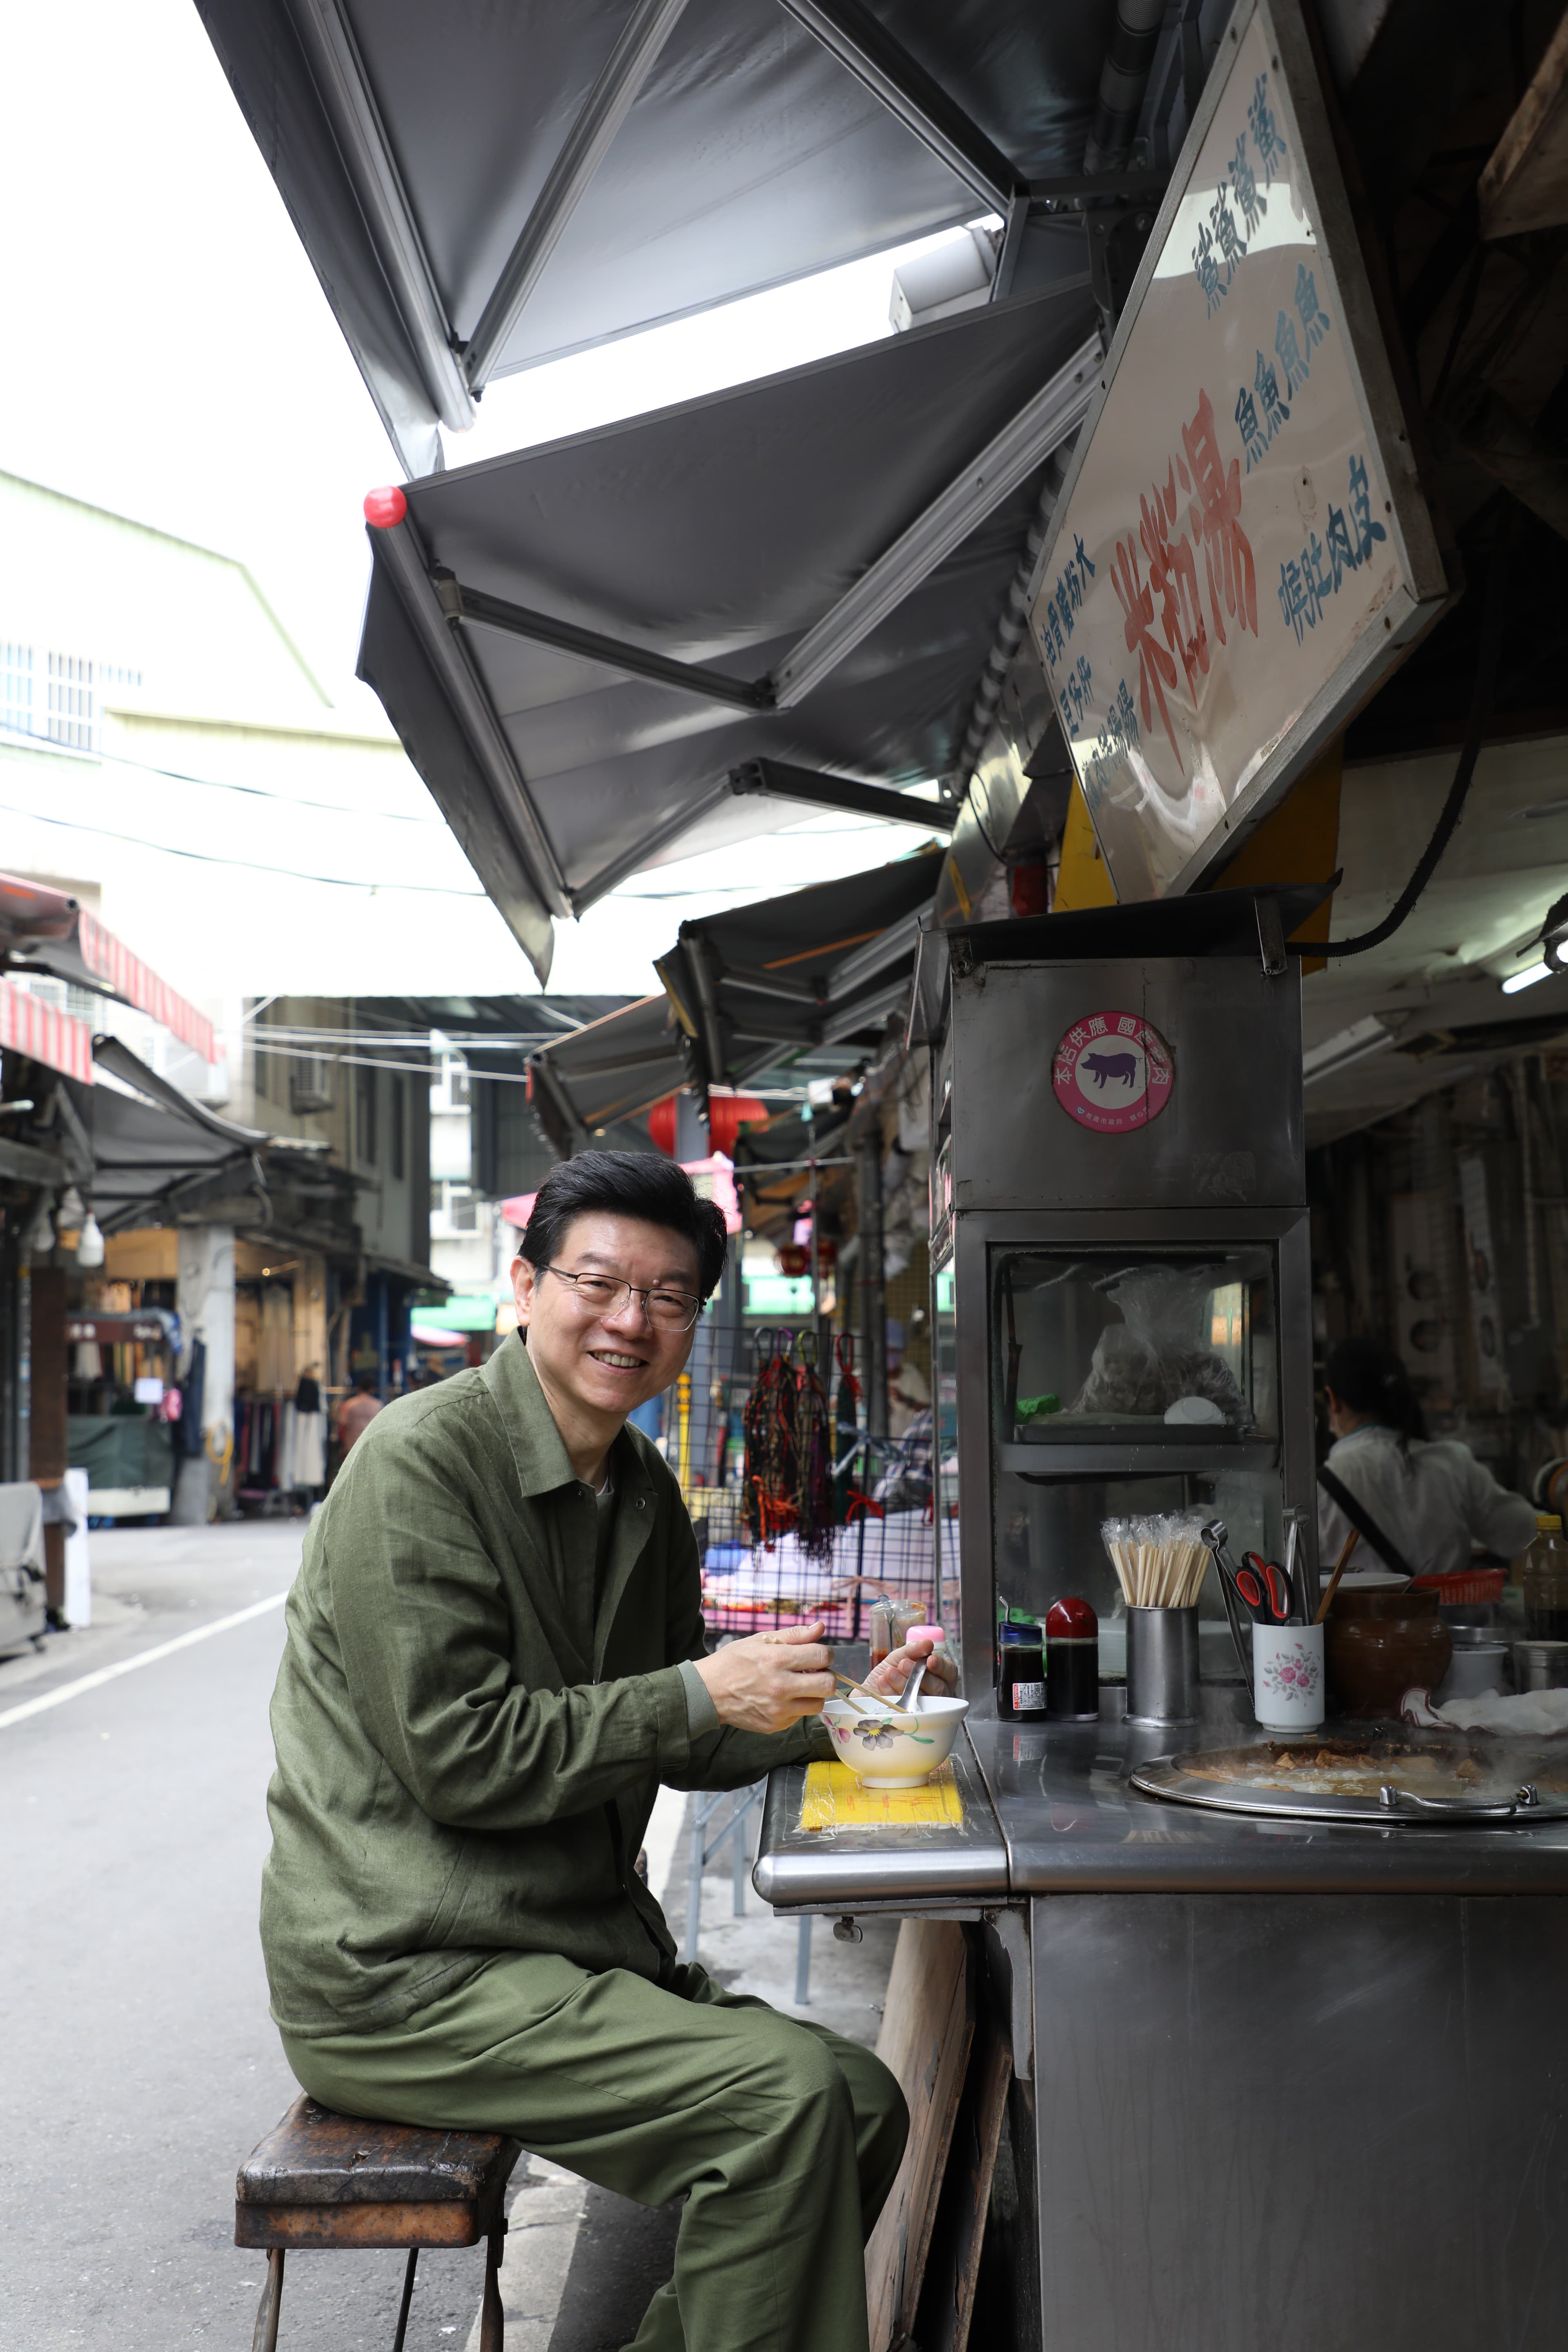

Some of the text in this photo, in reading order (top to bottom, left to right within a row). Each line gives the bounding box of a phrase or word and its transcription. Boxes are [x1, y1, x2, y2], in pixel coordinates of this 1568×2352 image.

[1110, 387, 1258, 777] 米粉湯
[1055, 1017, 1108, 1085] 本店供應
